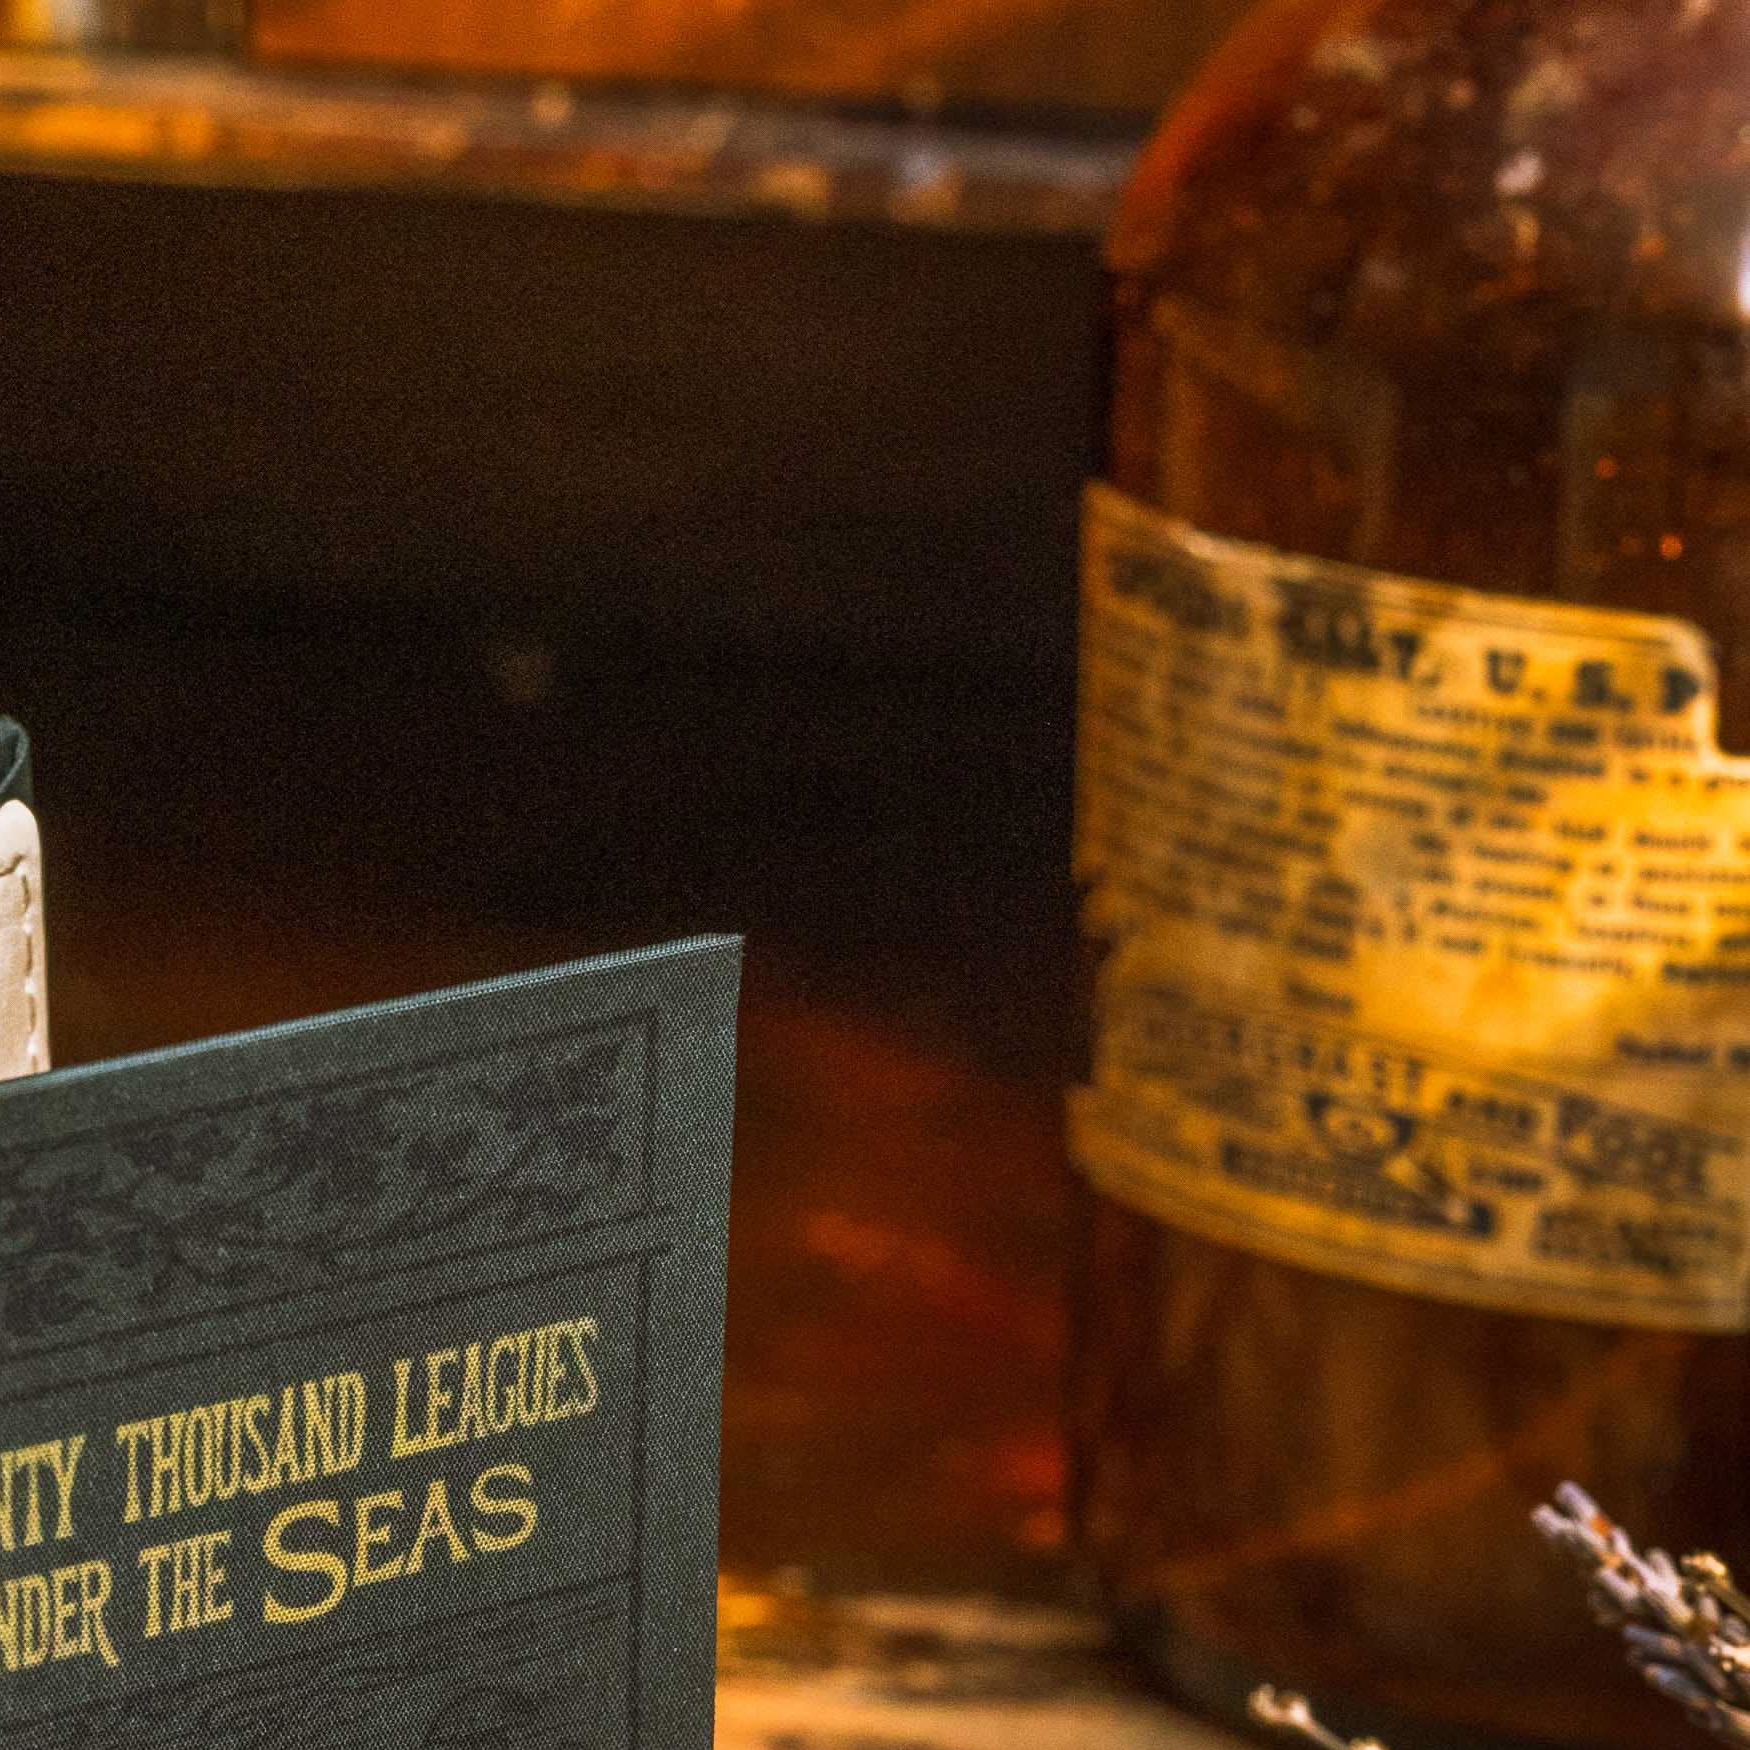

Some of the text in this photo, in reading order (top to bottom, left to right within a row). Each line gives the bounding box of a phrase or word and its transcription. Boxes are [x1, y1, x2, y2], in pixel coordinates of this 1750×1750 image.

[116, 1372, 366, 1524] THOUSAND
[391, 1317, 599, 1459] LEAGUES
[138, 1530, 234, 1640] THE
[262, 1463, 539, 1626] SEAS
